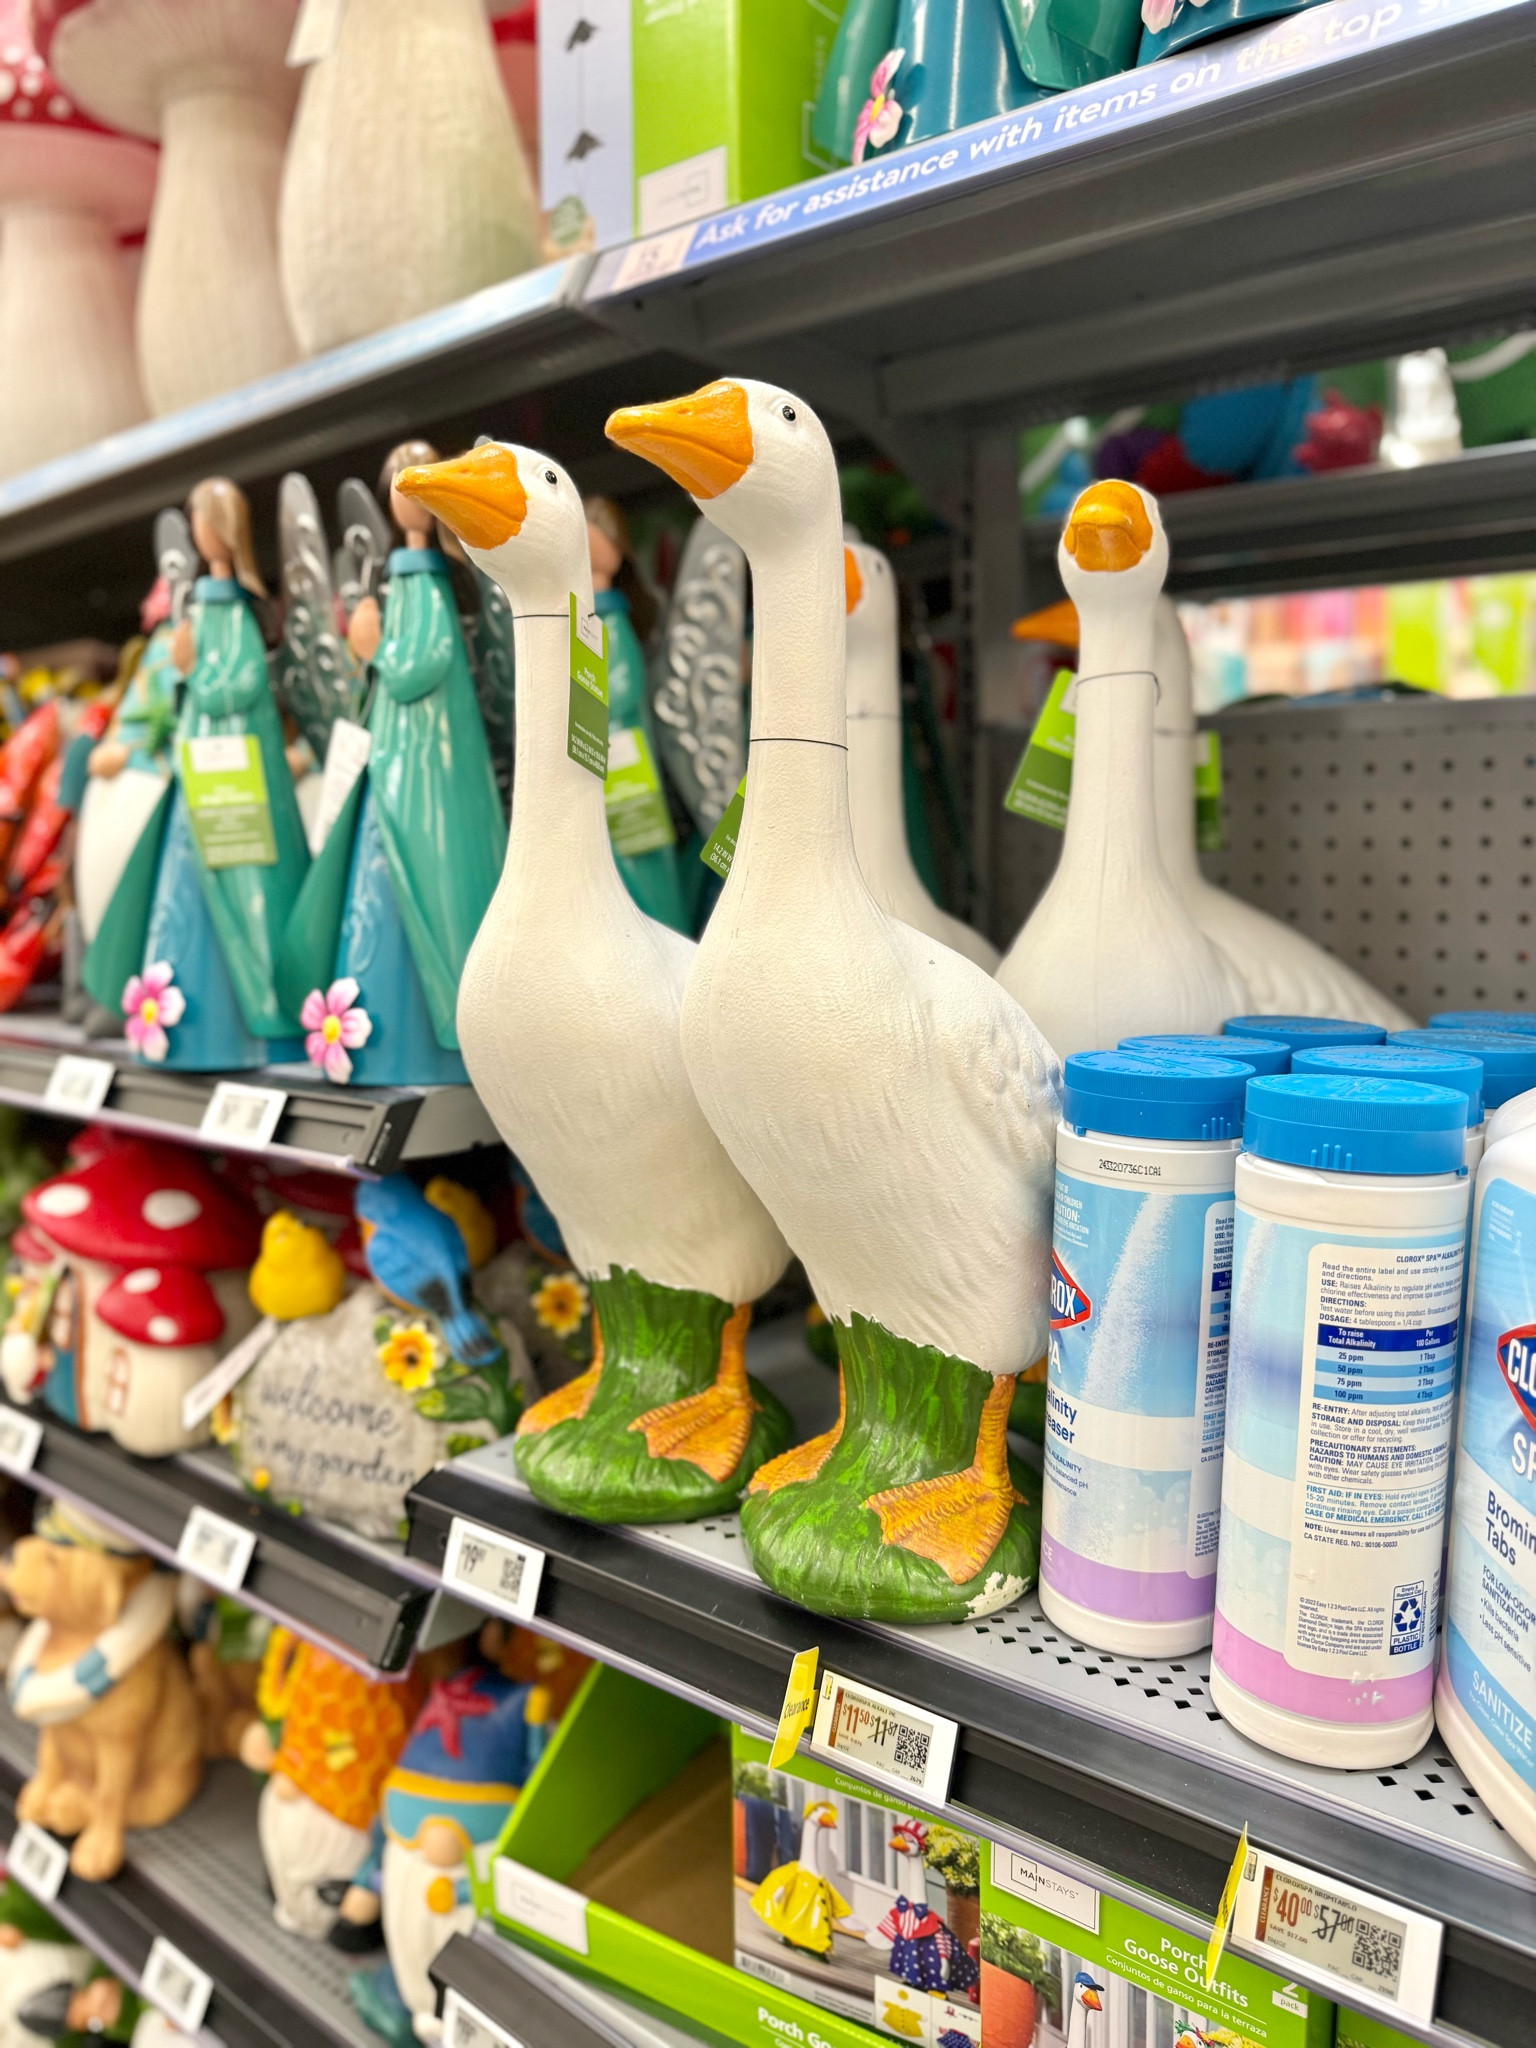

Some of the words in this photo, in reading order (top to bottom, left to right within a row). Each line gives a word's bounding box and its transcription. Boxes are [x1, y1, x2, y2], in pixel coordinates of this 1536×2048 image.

[693, 212, 750, 251] Ask
[753, 196, 804, 231] for
[802, 146, 959, 215] assistance
[969, 116, 1043, 161] with
[1052, 83, 1158, 134] items
[1170, 59, 1221, 95] on
[1236, 32, 1309, 72] the
[1323, 1, 1400, 45] top
[1323, 1262, 1340, 1271] Read
[1356, 1266, 1376, 1274] entire
[1378, 1266, 1395, 1274] label
[1337, 1272, 1373, 1281] directions.
[1321, 1279, 1338, 1287] USE:
[1340, 1281, 1360, 1289] Raises
[1363, 1283, 1392, 1292] Alkalinity
[1402, 1284, 1422, 1292] regulate
[1321, 1287, 1346, 1296] chlorine
[1348, 1290, 1389, 1299] effectiveness
[1321, 1296, 1366, 1307] DIRECTIONS:
[1320, 1313, 1351, 1323] DOSAGE:
[1334, 1306, 1352, 1315] water
[1354, 1307, 1375, 1316] before
[1377, 1309, 1392, 1318] using
[1338, 1328, 1346, 1336] To
[1329, 1336, 1344, 1344] Total
[1346, 1337, 1376, 1348] Alkalinity
[1425, 1338, 1440, 1346] Gallons
[1349, 1354, 1363, 1362] ppm
[1424, 1353, 1435, 1361] Tbsp
[1338, 1365, 1346, 1373] 50
[1348, 1367, 1363, 1375] ppm
[1423, 1365, 1434, 1374] Tbsp
[1337, 1378, 1345, 1386] 75
[1347, 1380, 1362, 1388] ppm
[259, 1363, 400, 1439] welcome
[1335, 1390, 1346, 1399] 100
[1348, 1392, 1363, 1400] ppm
[1313, 1403, 1350, 1414] RE-ENTRY:
[1369, 1410, 1396, 1418] adjusting
[1312, 1413, 1345, 1424] STORAGE
[1366, 1419, 1401, 1427] DISPOSAL:
[1311, 1429, 1340, 1439] collection
[1334, 1424, 1351, 1432] Store
[1310, 1439, 1370, 1452] PRECAUTIONARY
[1310, 1447, 1344, 1458] HAZARDS
[1357, 1453, 1388, 1461] HUMANS
[1406, 1450, 1432, 1460] DOMESTIC
[310, 1446, 416, 1487] garden
[1309, 1455, 1343, 1466] CAUTION:
[1347, 1460, 1362, 1468] MAY
[1366, 1461, 1389, 1469] CAUSE
[1323, 1473, 1339, 1481] other
[1341, 1475, 1373, 1484] chemicals.
[1343, 1467, 1359, 1475] Wear
[1361, 1468, 1379, 1476] safety
[1381, 1469, 1401, 1477] glasses
[1306, 1485, 1326, 1495] FIRST
[1306, 1493, 1324, 1502] 15-20
[1326, 1497, 1356, 1507] minutes.
[1389, 1500, 1411, 1508] contact
[1305, 1502, 1335, 1512] continue
[1337, 1506, 1360, 1515] rinsing
[1305, 1508, 1323, 1517] CASE
[1336, 1514, 1368, 1523] MEDICAL
[1371, 1515, 1411, 1523] EMERGENCY,
[1305, 1522, 1323, 1531] NOTE:
[1340, 1528, 1366, 1536] assumes
[1376, 1529, 1410, 1538] responsibility
[1314, 1535, 1333, 1544] STATE
[1335, 1538, 1349, 1546] REG.
[1485, 1516, 1516, 1566] Tabs
[1482, 1564, 1495, 1585] FOR
[1495, 1577, 1536, 1626] LOW-ODOR
[1481, 1578, 1529, 1633] SANITIZATION
[1494, 1610, 1519, 1642] bacteria
[1393, 1633, 1419, 1644] PLASTIC
[1394, 1642, 1417, 1653] BOTTLE
[1503, 1640, 1531, 1672] sensitive
[783, 1697, 810, 1719] Clearance
[1472, 1670, 1533, 1751] SANITIZE
[834, 1777, 872, 1795] Conjuntos
[873, 1790, 882, 1799] de
[1275, 1874, 1313, 1894] CLOROXSPA
[1260, 1887, 1270, 1924] CLEARANCE
[1269, 1923, 1285, 1934] SAVE
[1287, 1931, 1308, 1944] $17.00
[1161, 1937, 1208, 1970] Porch
[1124, 1938, 1178, 1975] Goose
[1184, 1967, 1249, 2008] Outfits
[1106, 1955, 1151, 1982] Conjuntos
[1153, 1977, 1165, 1989] de
[1166, 1985, 1194, 2003] ganso
[1197, 1999, 1218, 2015] para
[1221, 2008, 1230, 2020] la
[1232, 2014, 1267, 2038] terraza
[1280, 1998, 1299, 2011] pack
[757, 2006, 804, 2041] Porch
